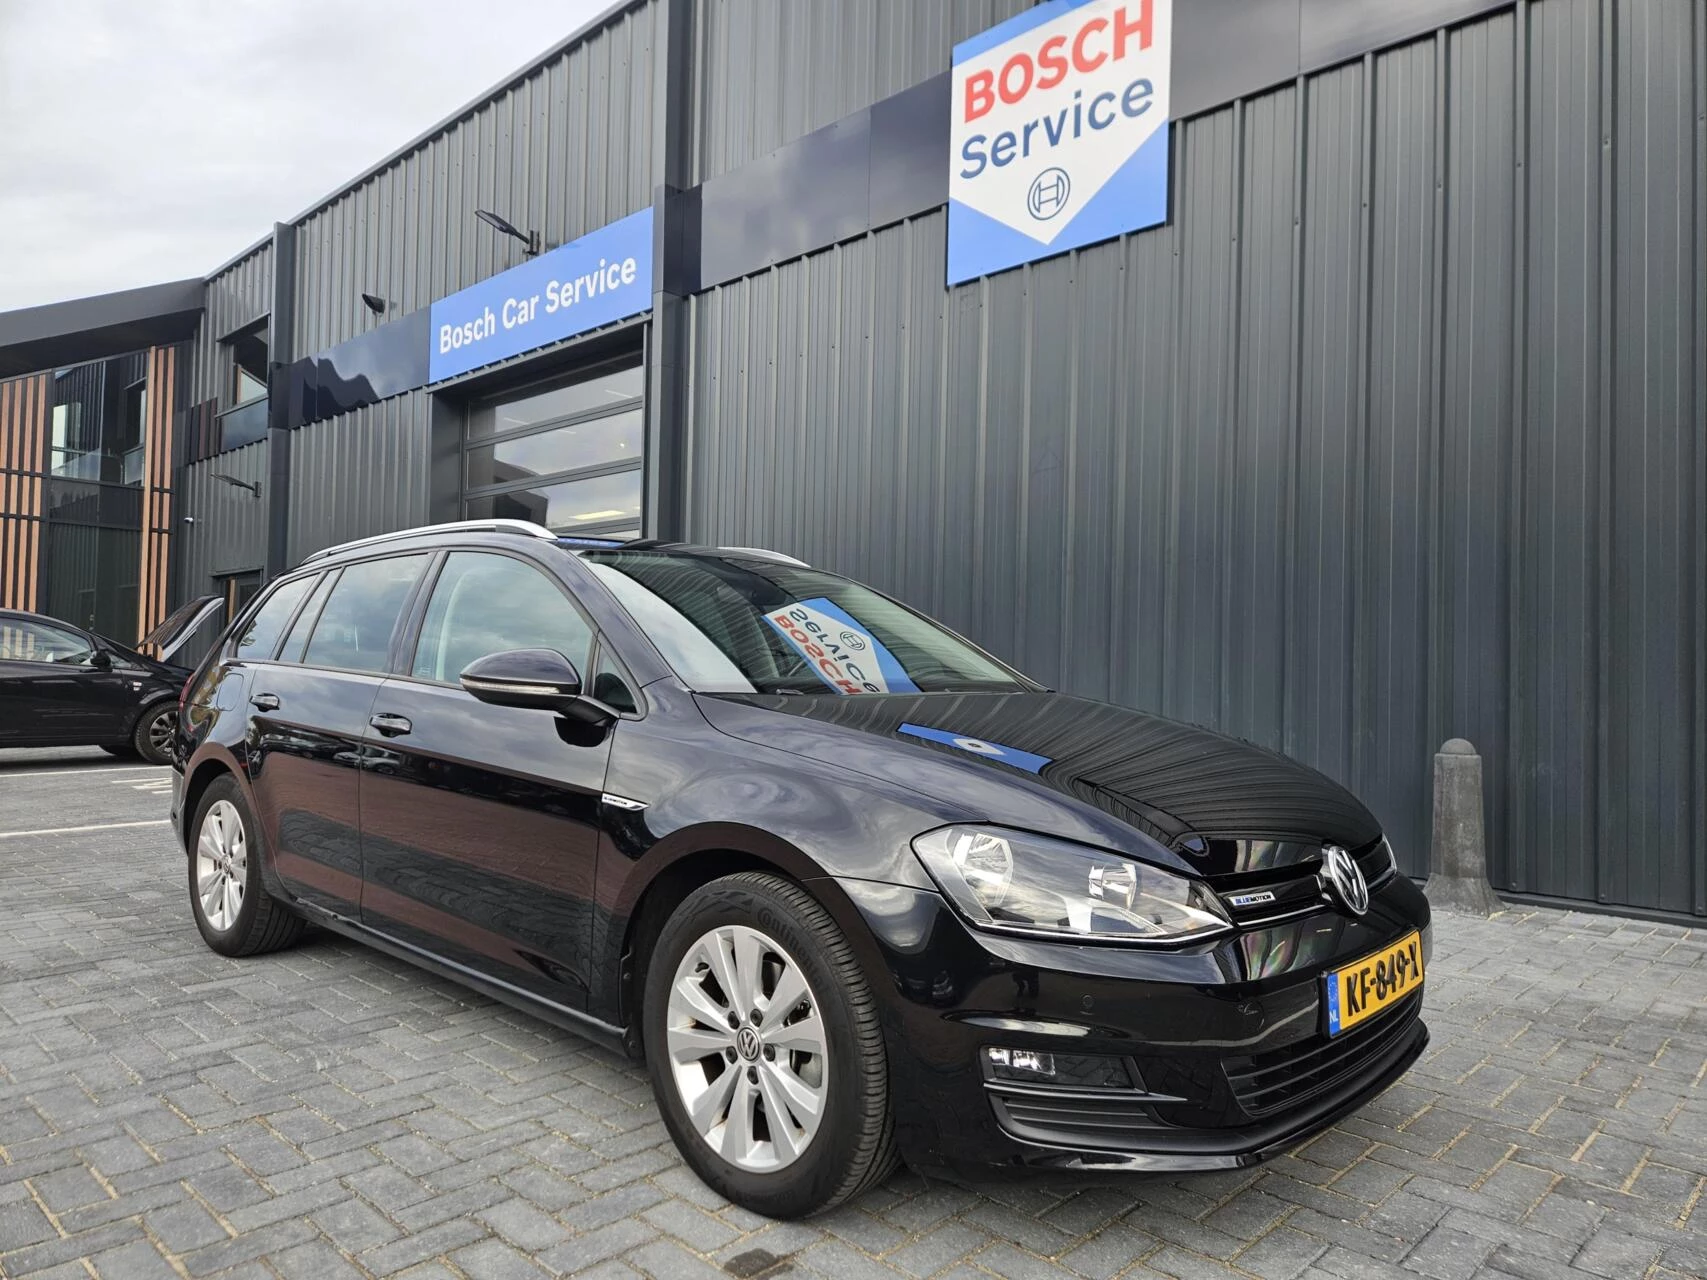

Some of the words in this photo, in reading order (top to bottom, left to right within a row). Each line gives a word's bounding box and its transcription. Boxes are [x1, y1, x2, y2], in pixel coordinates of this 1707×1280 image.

[964, 0, 1153, 123] BOSCH
[960, 78, 1154, 179] Service
[440, 306, 495, 354] Bosch
[502, 294, 540, 329] Car
[545, 257, 637, 313] Service
[1329, 1009, 1339, 1024] NL
[1346, 941, 1419, 1017] KF-849-X
